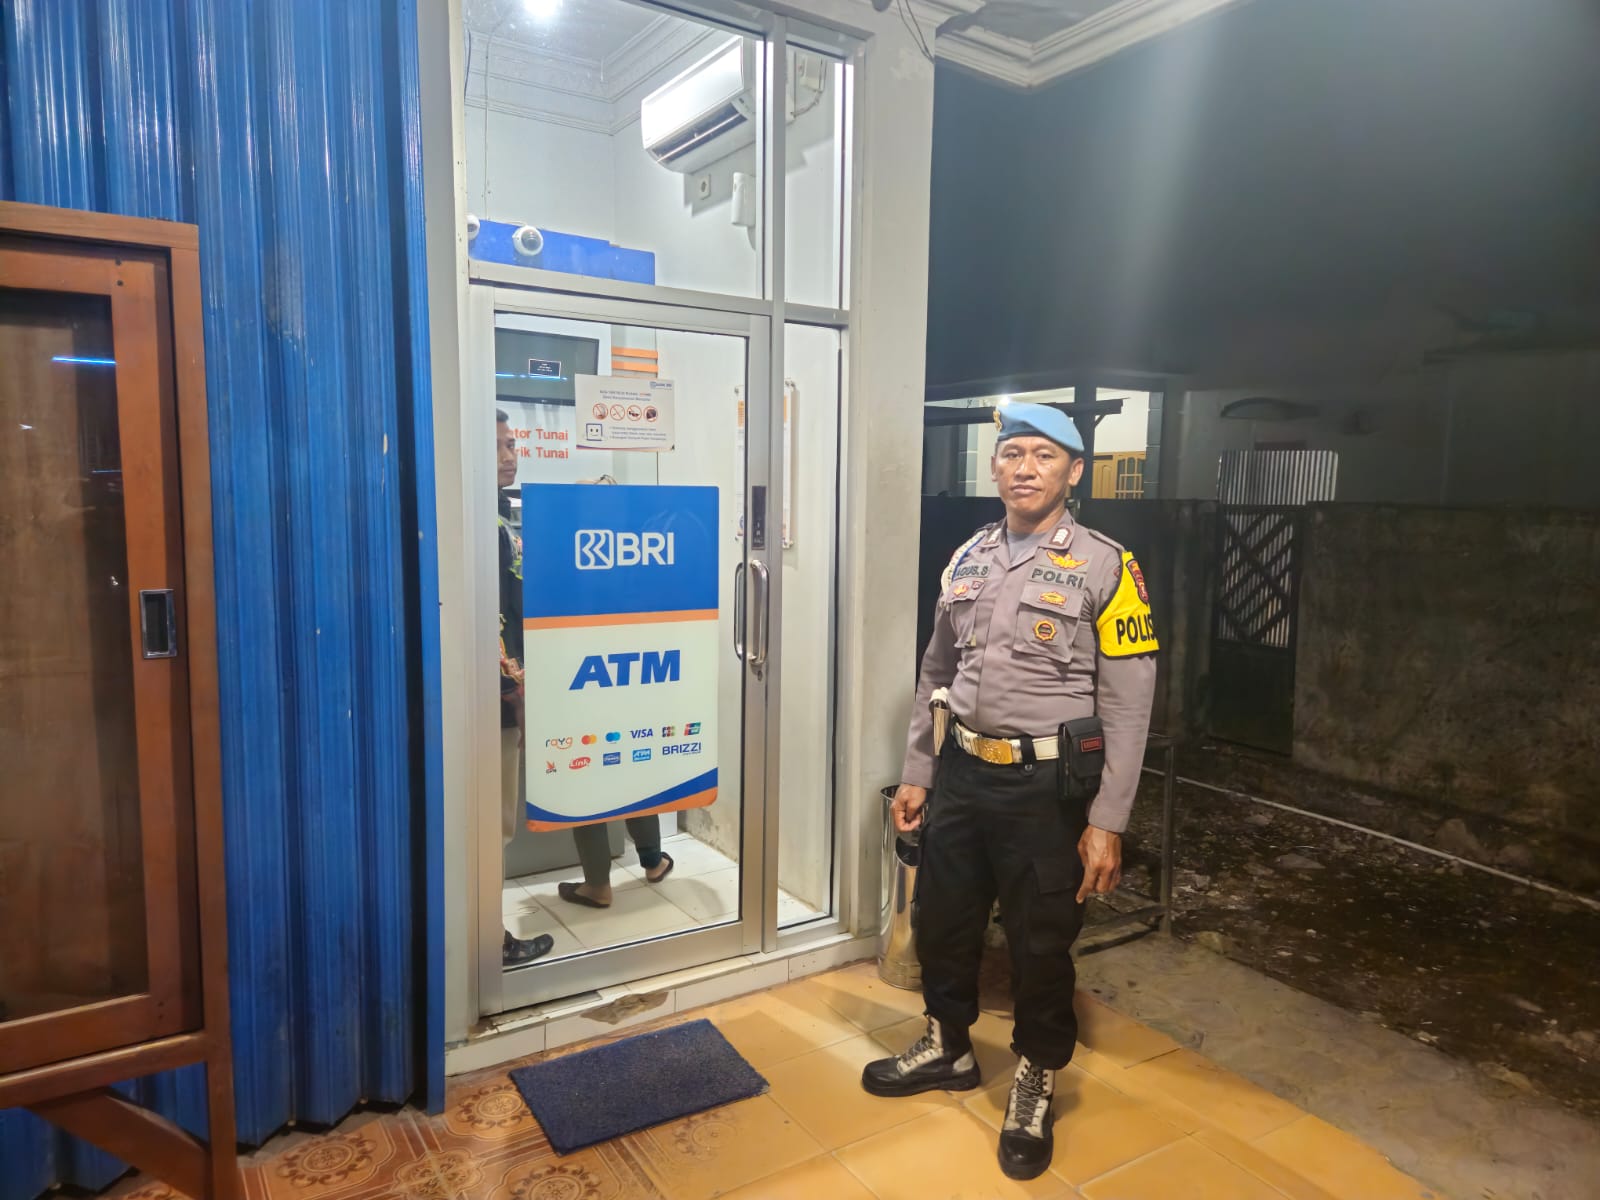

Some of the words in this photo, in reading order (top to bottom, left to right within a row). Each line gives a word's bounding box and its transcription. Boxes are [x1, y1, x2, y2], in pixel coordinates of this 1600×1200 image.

[513, 428, 532, 439] tor
[535, 428, 569, 440] Tunai
[535, 446, 569, 459] Tunai
[616, 532, 675, 566] BRI
[1031, 567, 1085, 589] POLRI
[569, 650, 681, 690] ATM
[629, 728, 653, 739] VISA
[662, 742, 702, 756] BRIZZI
